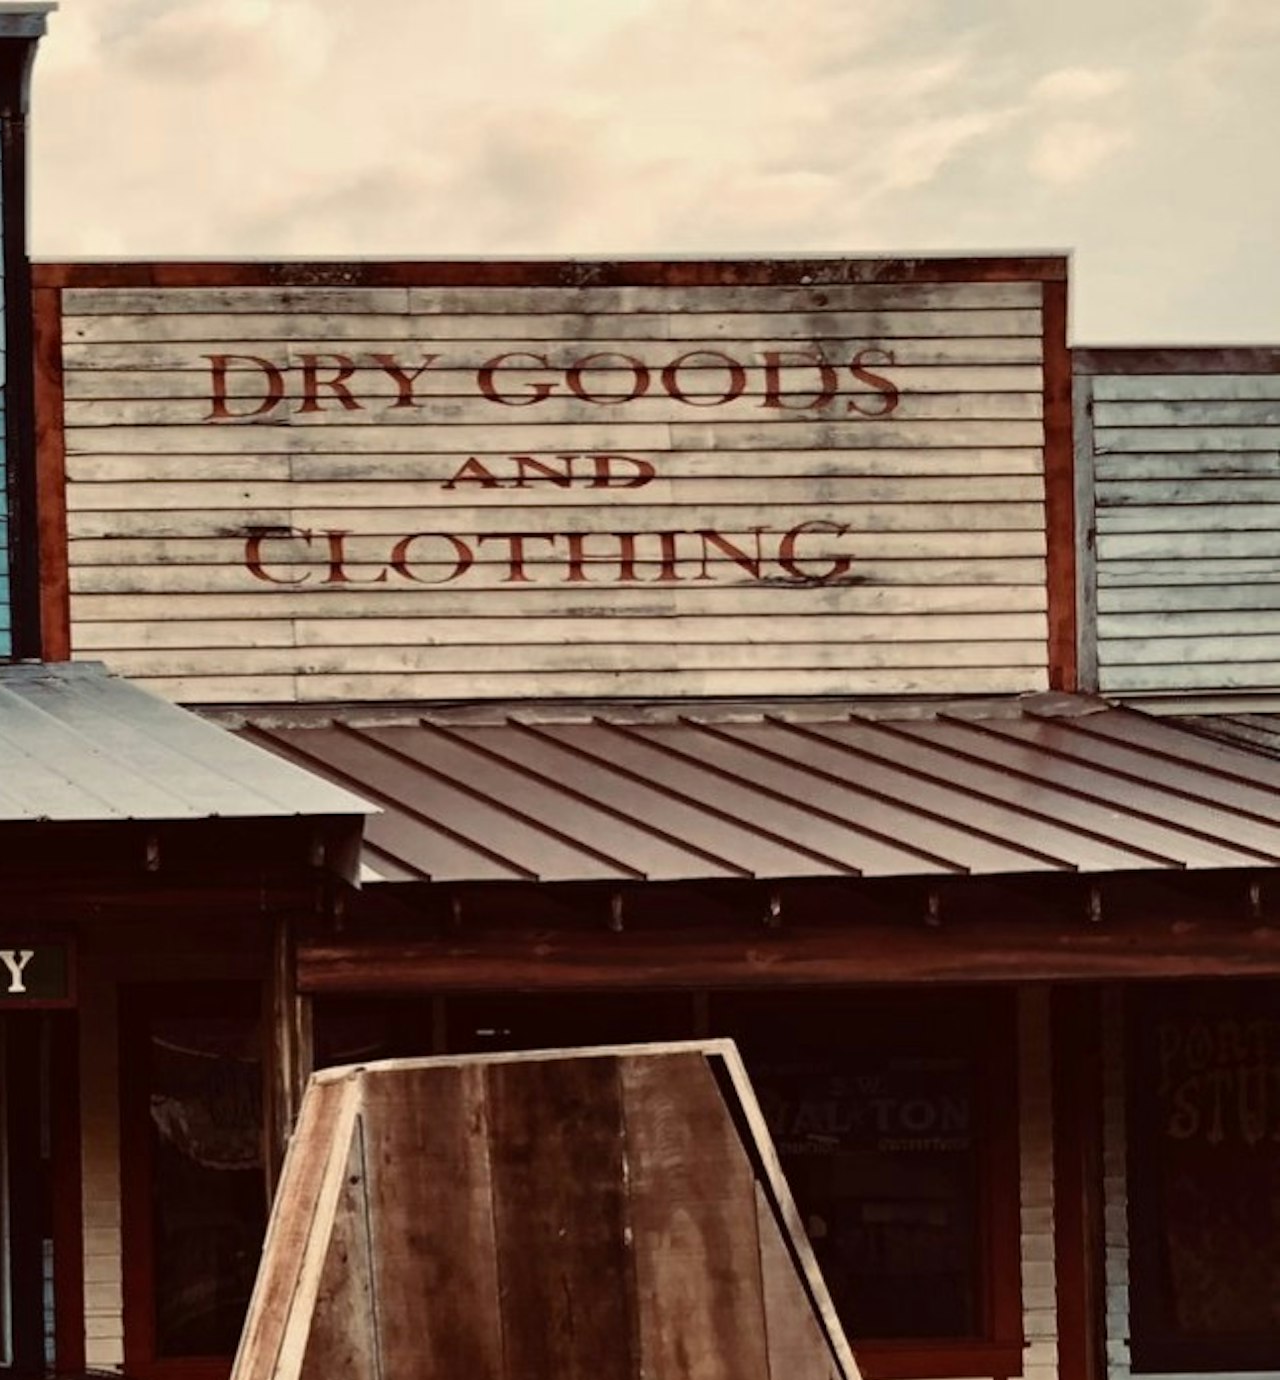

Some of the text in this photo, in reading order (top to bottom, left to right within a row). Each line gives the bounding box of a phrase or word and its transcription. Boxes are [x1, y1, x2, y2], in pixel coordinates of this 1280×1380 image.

[199, 349, 901, 424] DRY GOODS
[441, 454, 656, 489] AND
[243, 520, 854, 585] CLOTHING
